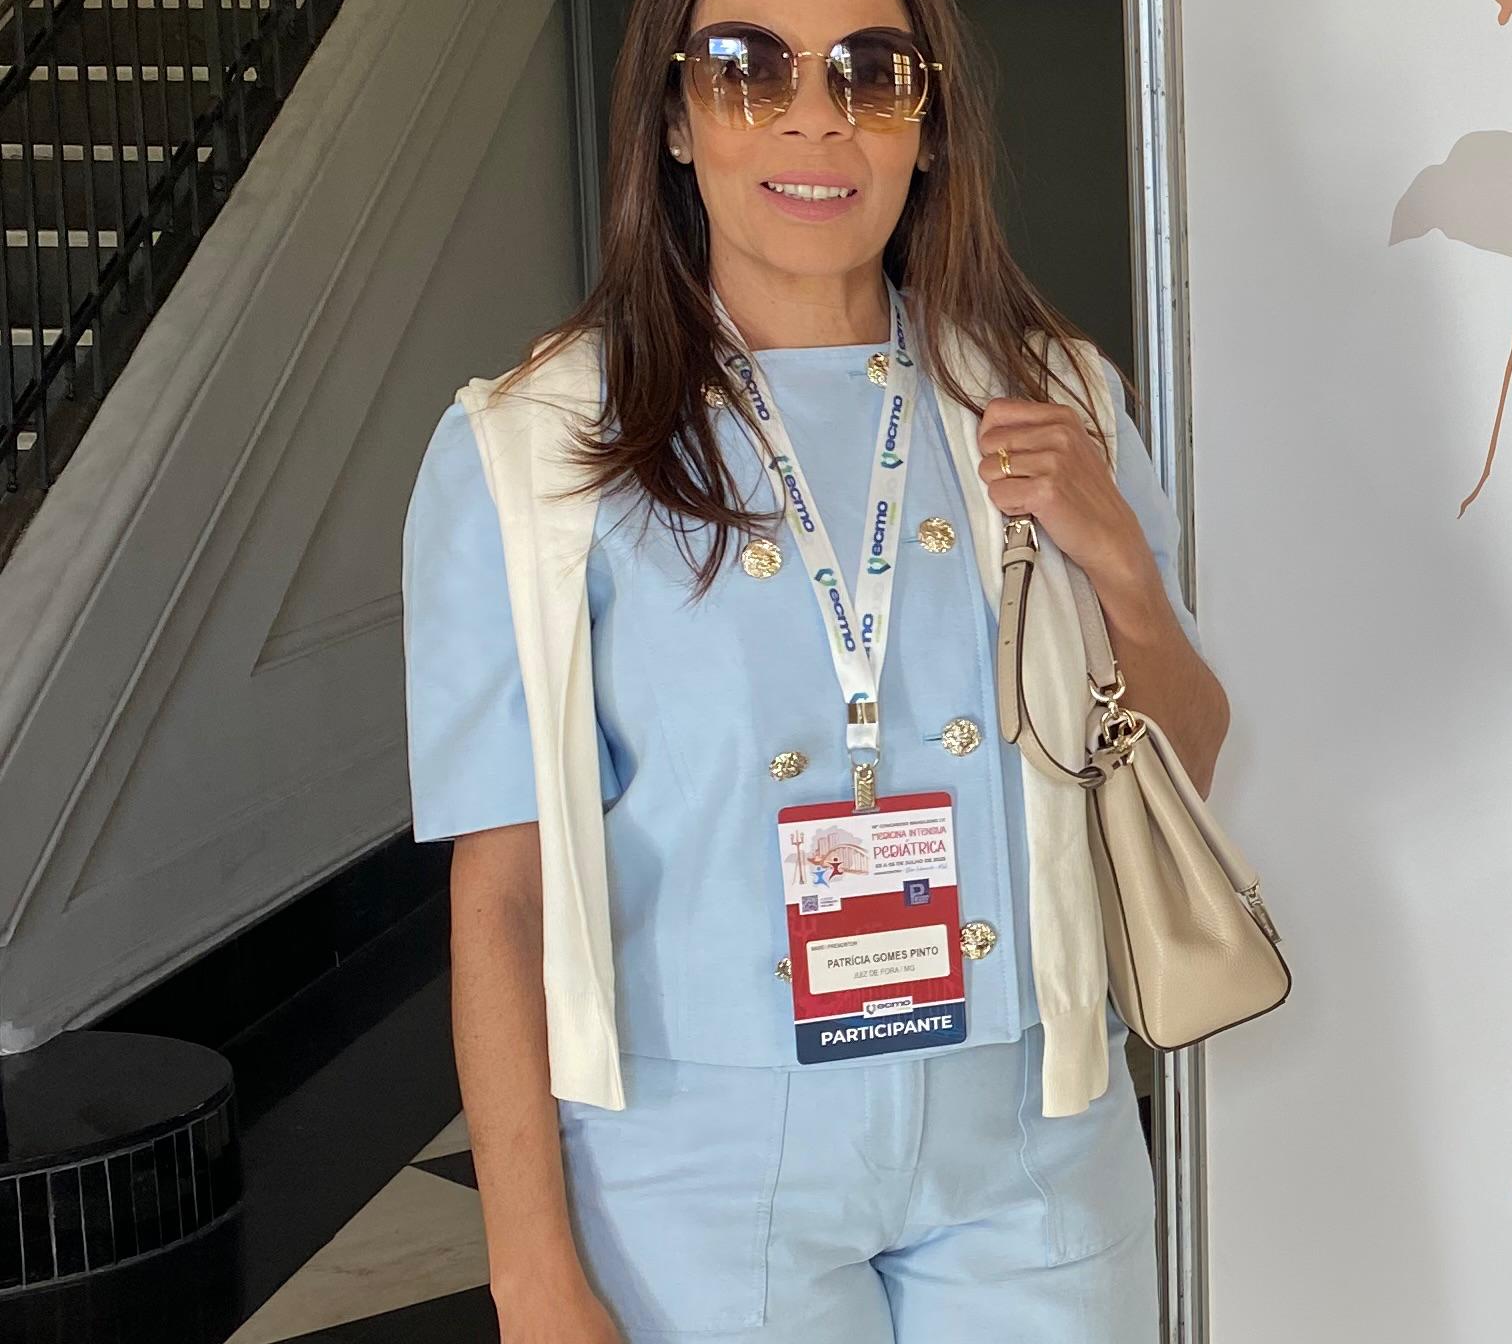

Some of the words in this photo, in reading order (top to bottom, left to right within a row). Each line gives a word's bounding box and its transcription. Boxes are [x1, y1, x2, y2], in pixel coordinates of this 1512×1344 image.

[885, 395, 903, 452] ecmo
[785, 474, 815, 533] ecmo
[871, 501, 888, 556] ecmo
[829, 588, 856, 652] ecmo
[827, 954, 871, 969] PATRÍCIA
[873, 950, 908, 963] GOMES
[910, 946, 939, 958] PINTO
[869, 969, 879, 977] DE
[880, 967, 899, 976] FORA
[904, 965, 915, 973] MG
[820, 1015, 953, 1046] PARTICIPANTE
